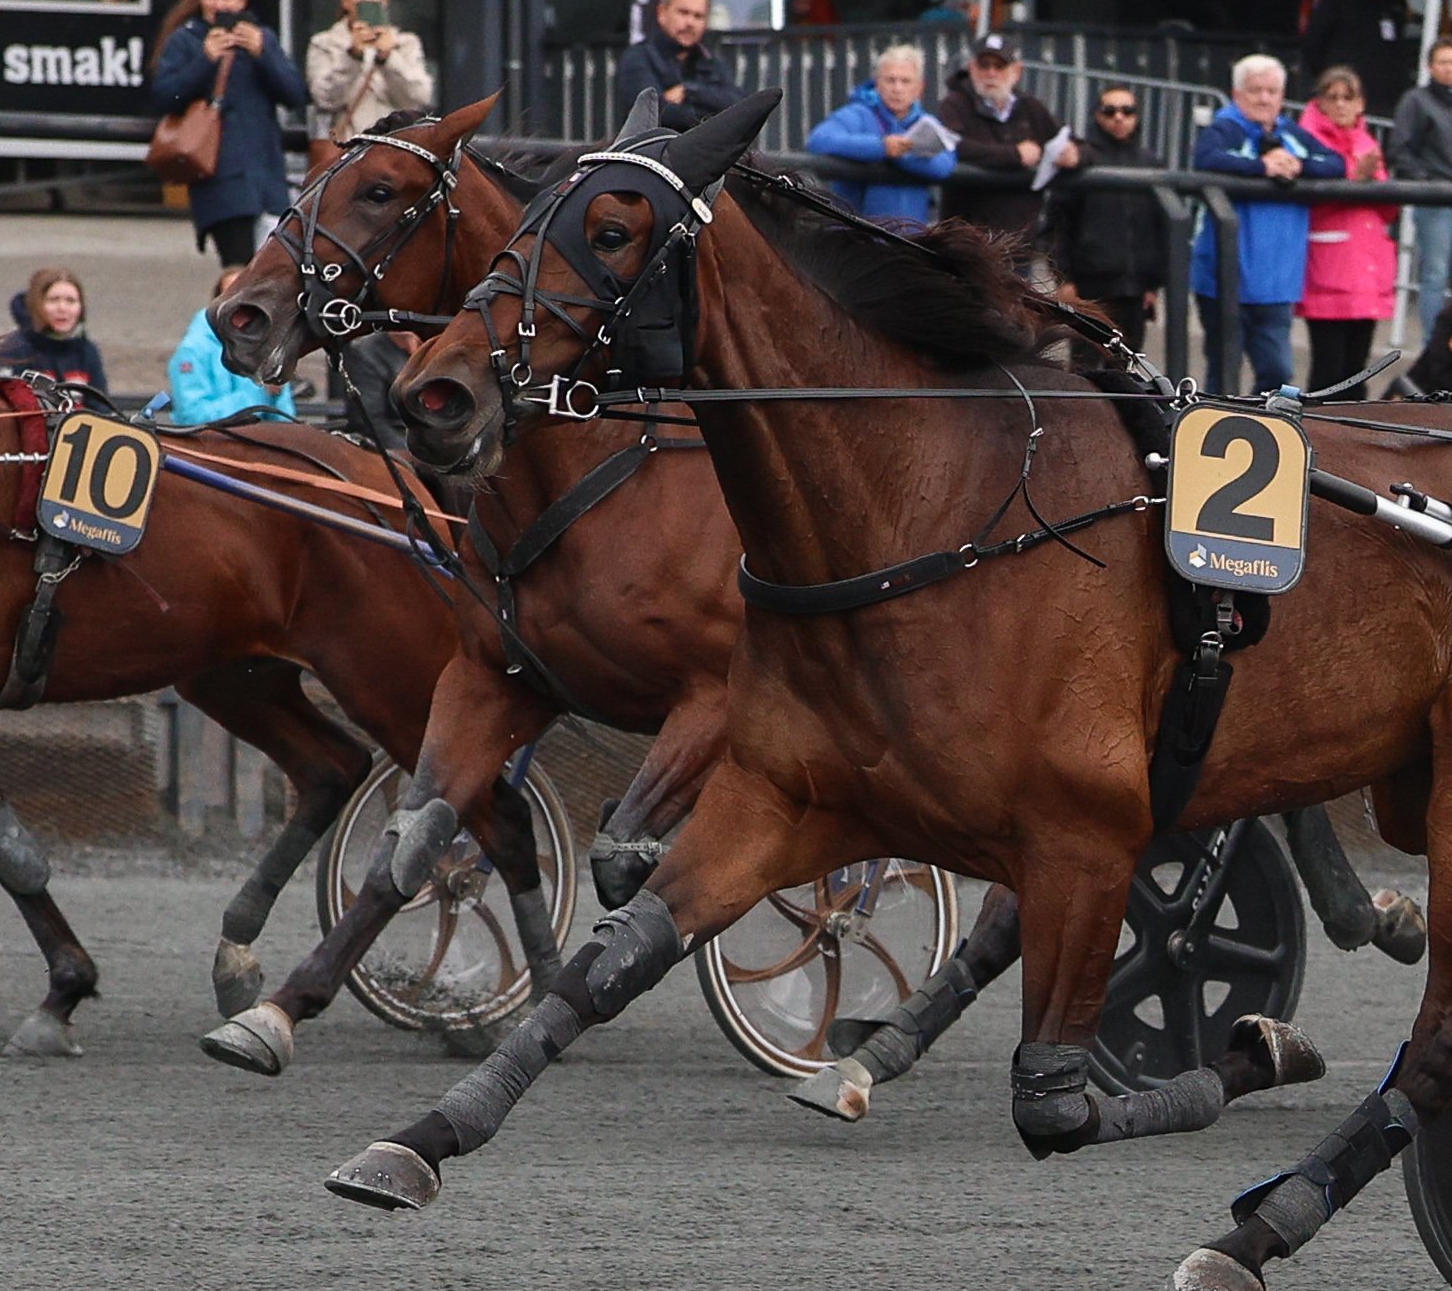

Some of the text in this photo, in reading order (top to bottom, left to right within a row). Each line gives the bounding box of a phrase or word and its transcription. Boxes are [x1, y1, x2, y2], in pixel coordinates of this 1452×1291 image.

[3, 35, 143, 87] smak!
[60, 423, 151, 518] 10
[1196, 416, 1280, 542] 2
[68, 517, 122, 546] Megaflis
[1209, 552, 1279, 578] Megaflis
